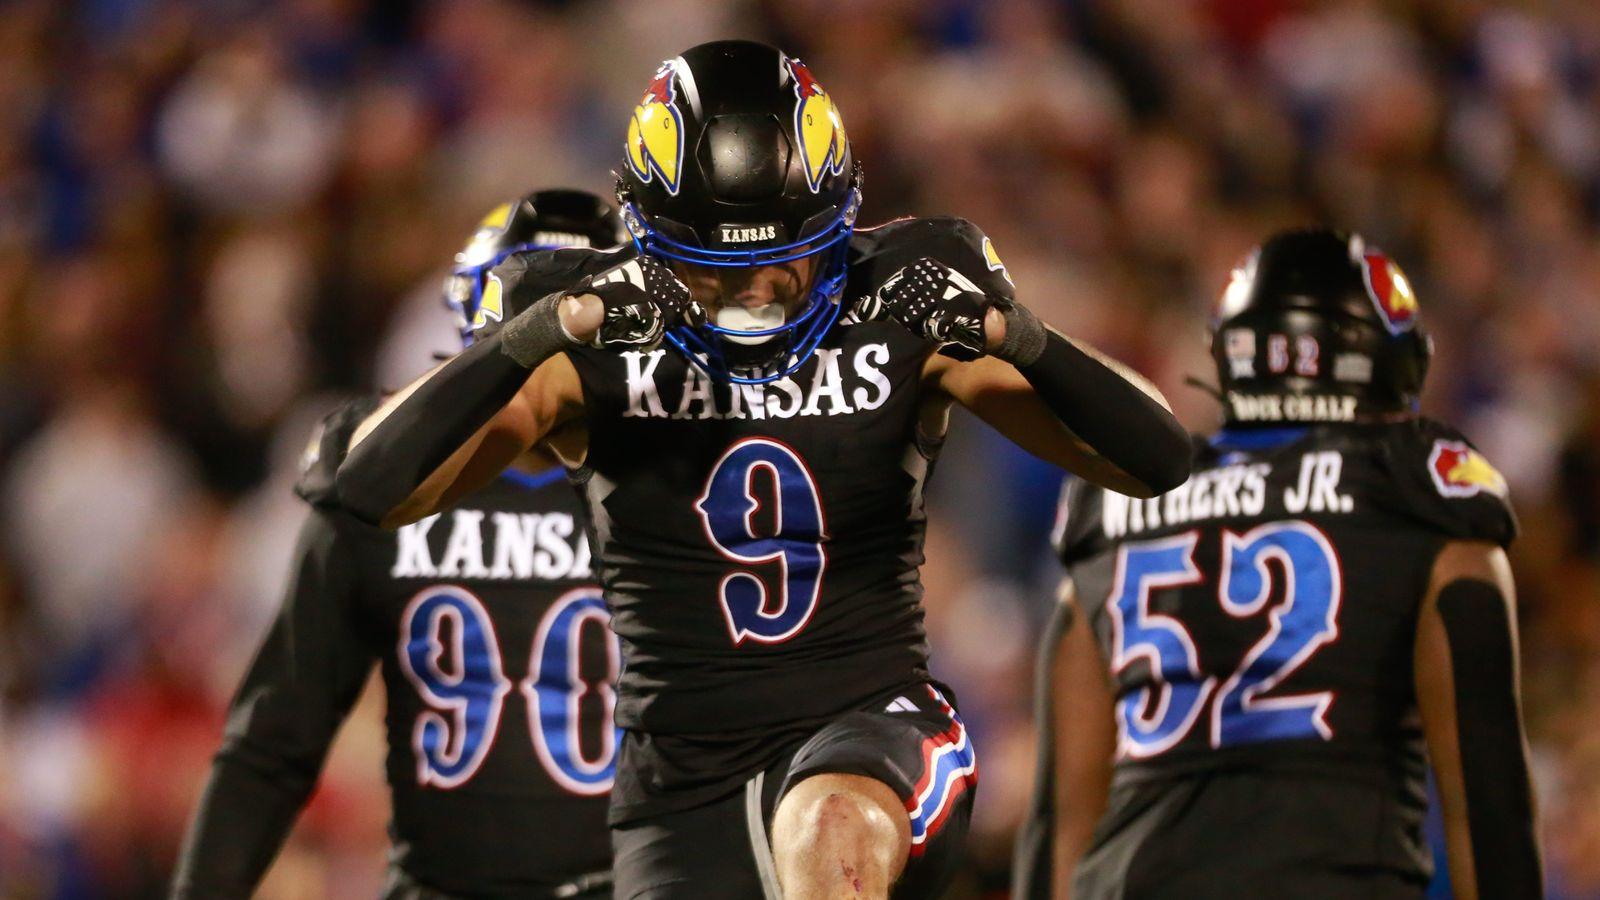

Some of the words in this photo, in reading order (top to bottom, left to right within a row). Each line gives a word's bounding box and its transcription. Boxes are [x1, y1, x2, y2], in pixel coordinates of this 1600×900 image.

[721, 226, 776, 243] KANSAS
[619, 343, 892, 420] KANSAS
[1283, 394, 1357, 422] CHALK
[1283, 450, 1354, 513] JR.
[692, 435, 832, 648] 9
[1106, 519, 1343, 761] 52
[397, 584, 622, 796] 90
